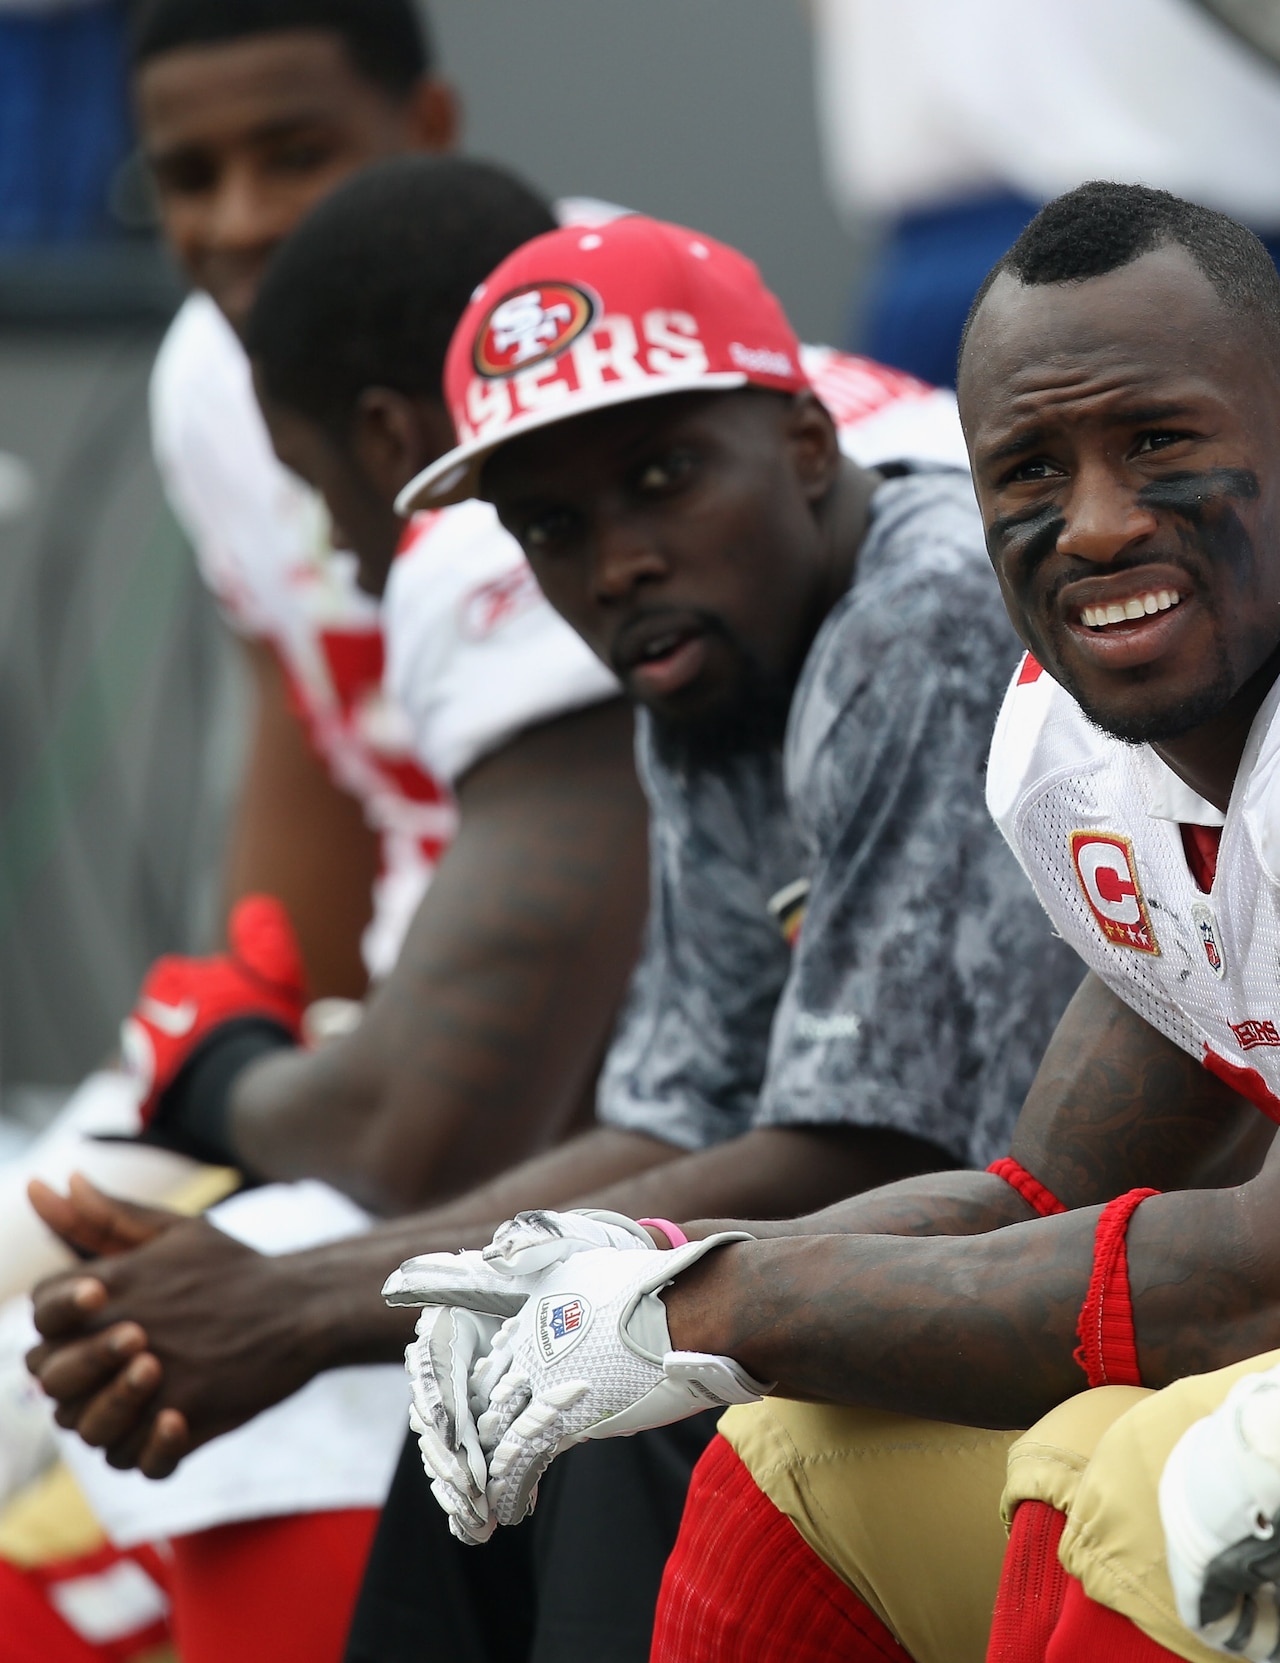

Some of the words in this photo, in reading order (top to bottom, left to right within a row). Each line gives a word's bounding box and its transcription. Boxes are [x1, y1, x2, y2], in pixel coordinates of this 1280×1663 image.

[459, 309, 710, 443] 9ERS
[1077, 842, 1141, 925] C
[540, 1301, 554, 1358] EQUIPMENT
[564, 1301, 582, 1332] NFL
